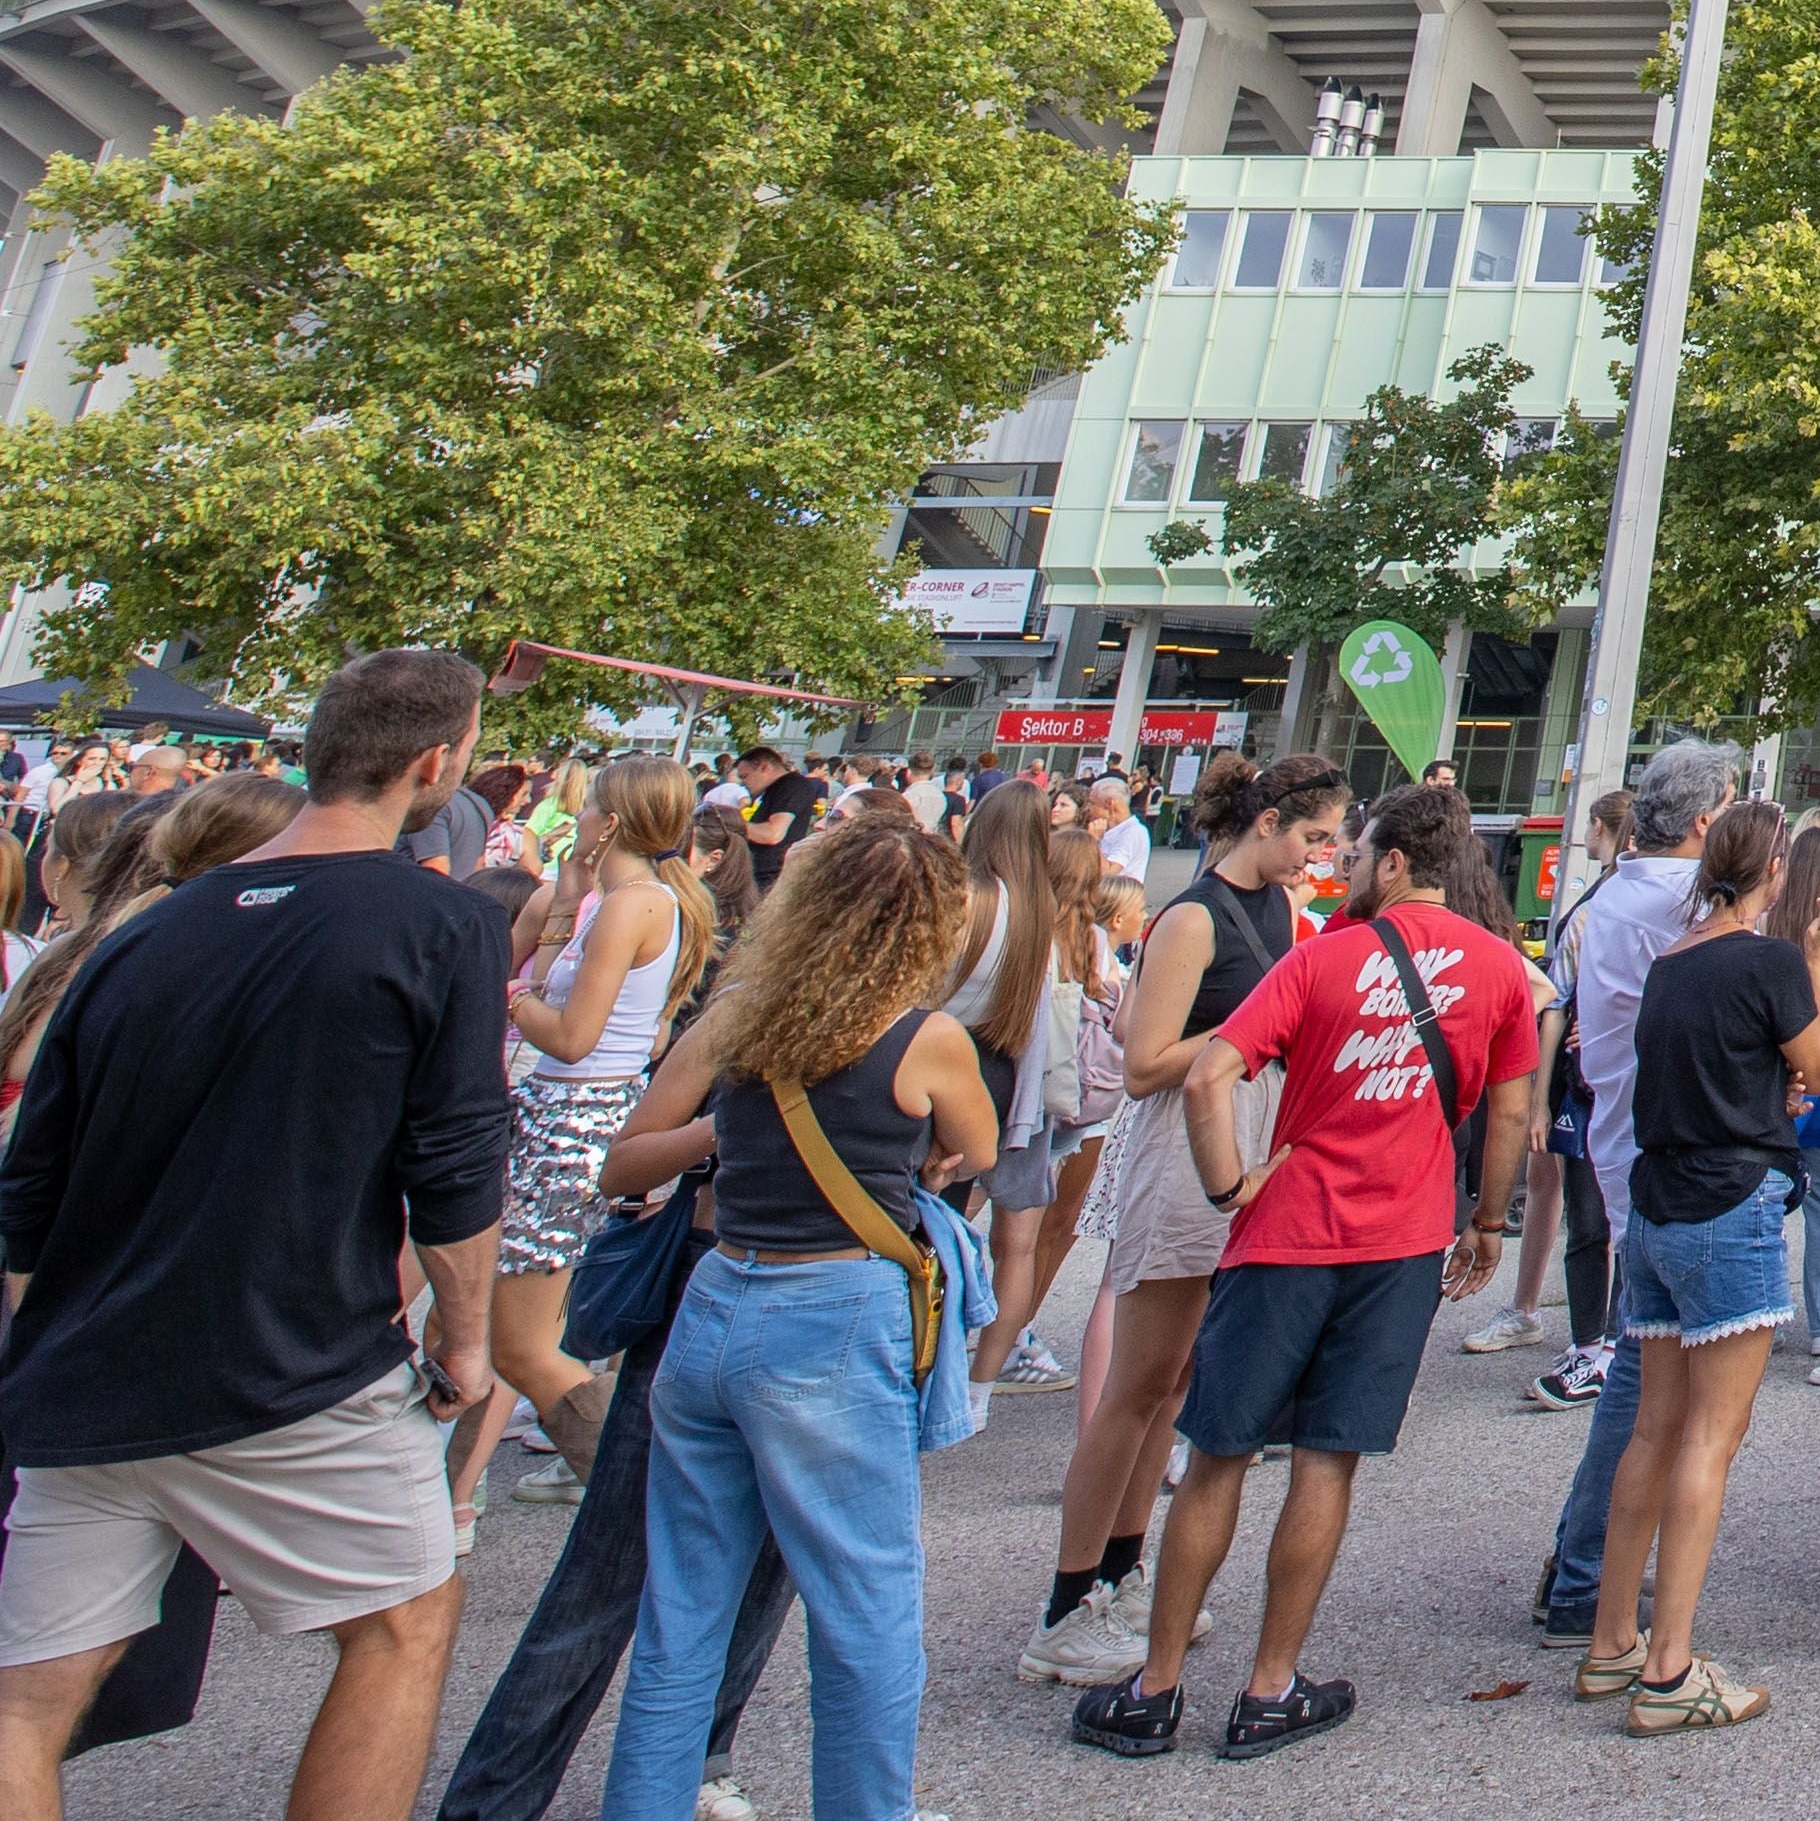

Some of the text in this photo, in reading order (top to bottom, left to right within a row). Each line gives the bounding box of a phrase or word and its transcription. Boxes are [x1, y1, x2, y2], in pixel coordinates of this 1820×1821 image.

[1020, 716, 1084, 737] Sektor B
[1333, 1020, 1424, 1073] WHY
[1354, 1063, 1434, 1101] NOT?
